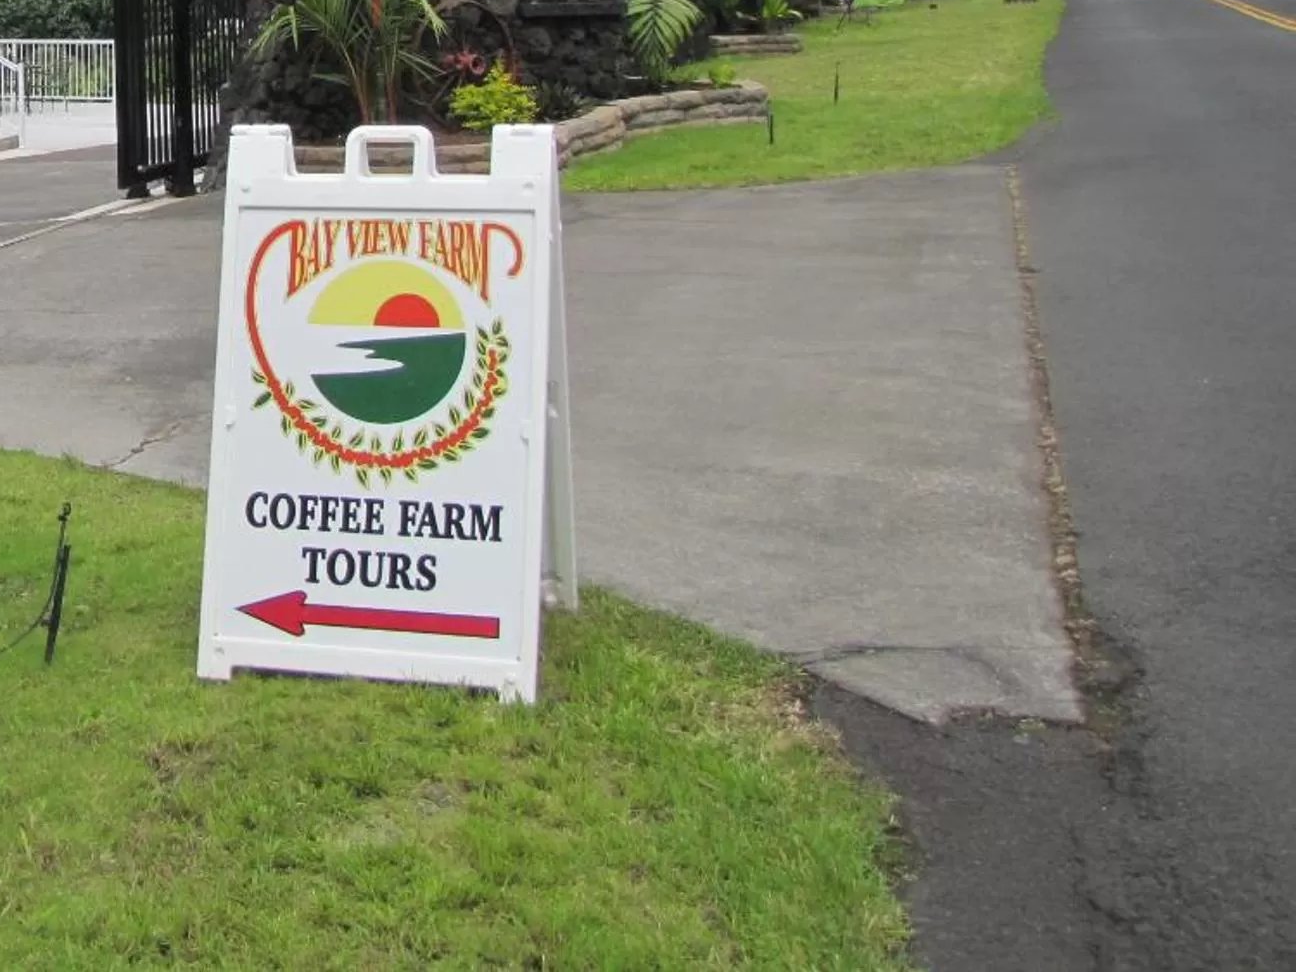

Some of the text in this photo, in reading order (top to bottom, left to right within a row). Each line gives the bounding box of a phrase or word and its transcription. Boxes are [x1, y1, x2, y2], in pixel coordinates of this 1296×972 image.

[286, 217, 490, 304] BAY VIEW FARM
[245, 491, 503, 542] COFFEE FARM
[301, 546, 437, 592] TOURS
